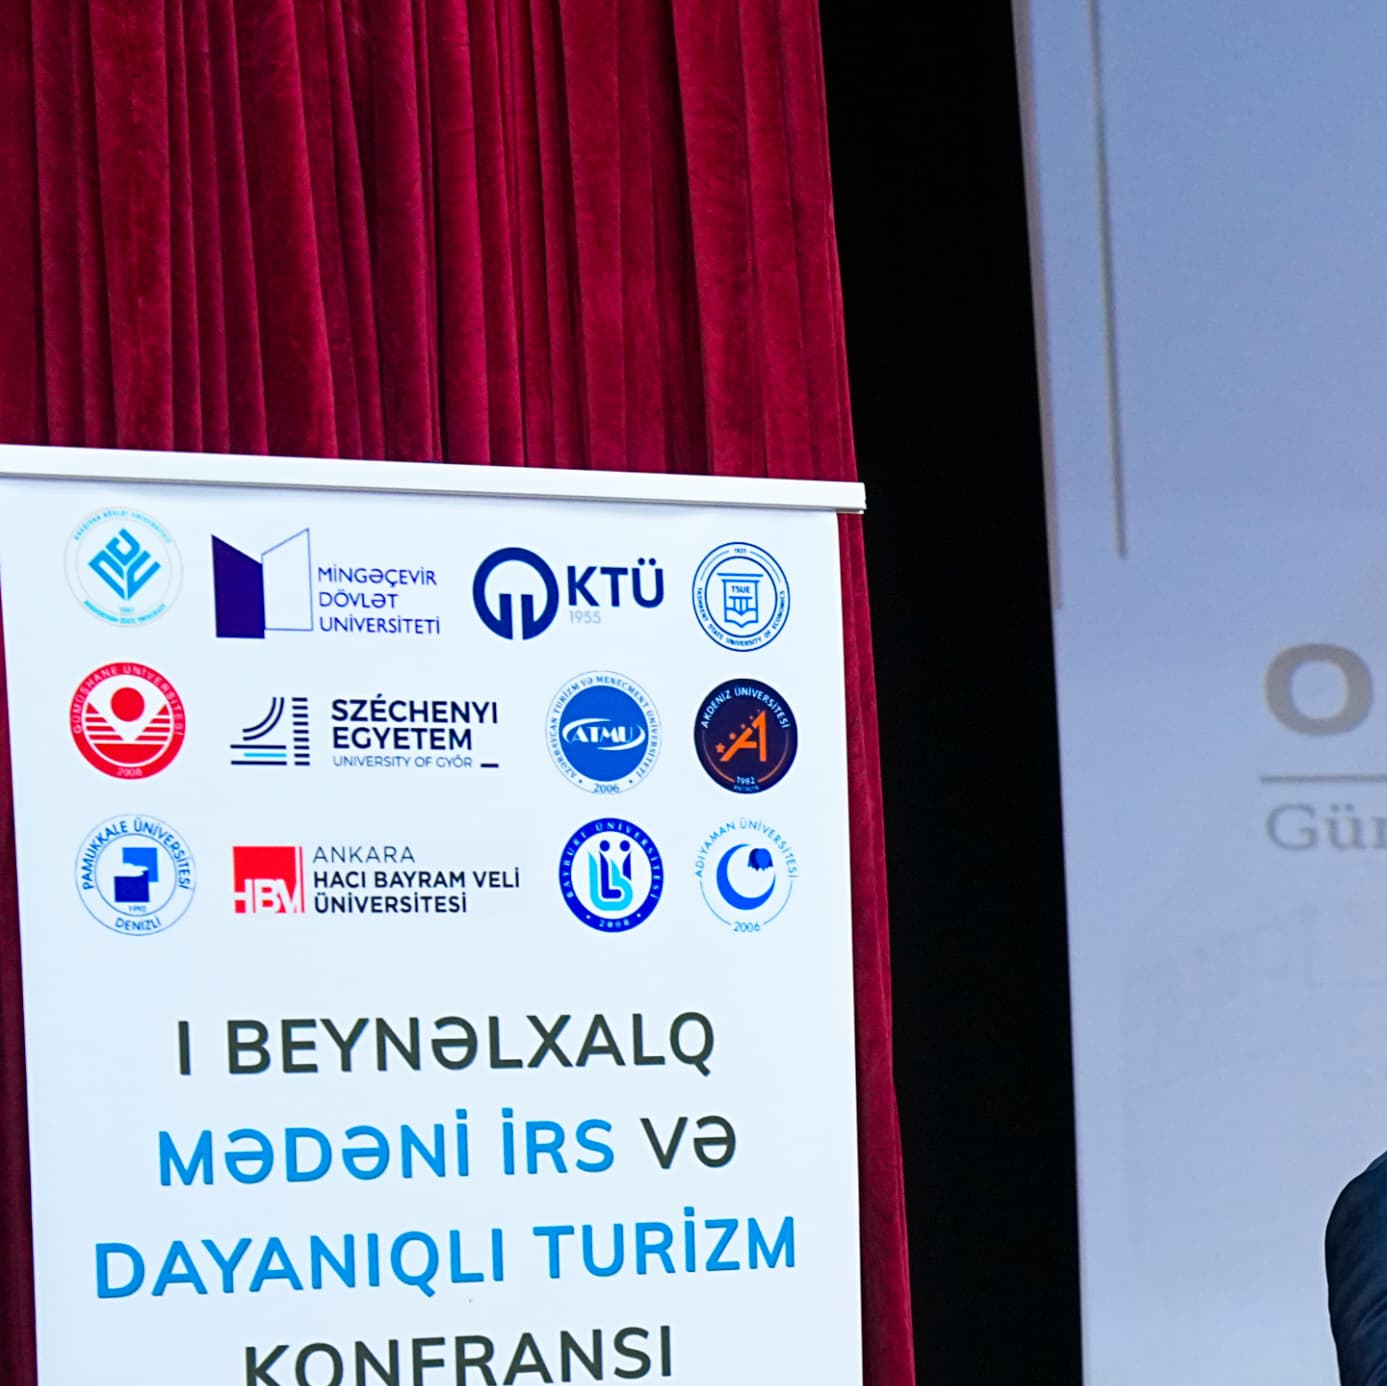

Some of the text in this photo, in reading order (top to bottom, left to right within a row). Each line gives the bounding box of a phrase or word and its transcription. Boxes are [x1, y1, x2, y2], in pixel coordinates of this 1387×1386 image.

[318, 563, 437, 588] MİNGƏÇEVİR
[567, 557, 664, 608] KTÜ
[319, 589, 399, 609] DÖVLƏT
[319, 614, 440, 634] UNİVERSİTETİ
[569, 610, 601, 624] 1955
[331, 693, 498, 724] SZÉCHENYI
[333, 726, 472, 751] EGYETEM
[571, 725, 633, 743] ATMU
[333, 755, 410, 767] UNIVERSITY
[414, 756, 432, 768] OF
[592, 783, 620, 794] 2006
[81, 820, 129, 891] PAMUKKALE
[312, 846, 416, 864] ANKARA
[695, 821, 736, 878] ADIYAMAN
[313, 867, 520, 888] HACI BAYRAM VELİ
[314, 892, 468, 913] ÜNİVERSİTESİ
[733, 921, 761, 933] 2006
[177, 1011, 716, 1077] I BEYNƏLXALQ
[157, 1106, 737, 1187] MƏDƏNİ İRS VƏ
[94, 1206, 797, 1299] DAYANIQLI TURİZM
